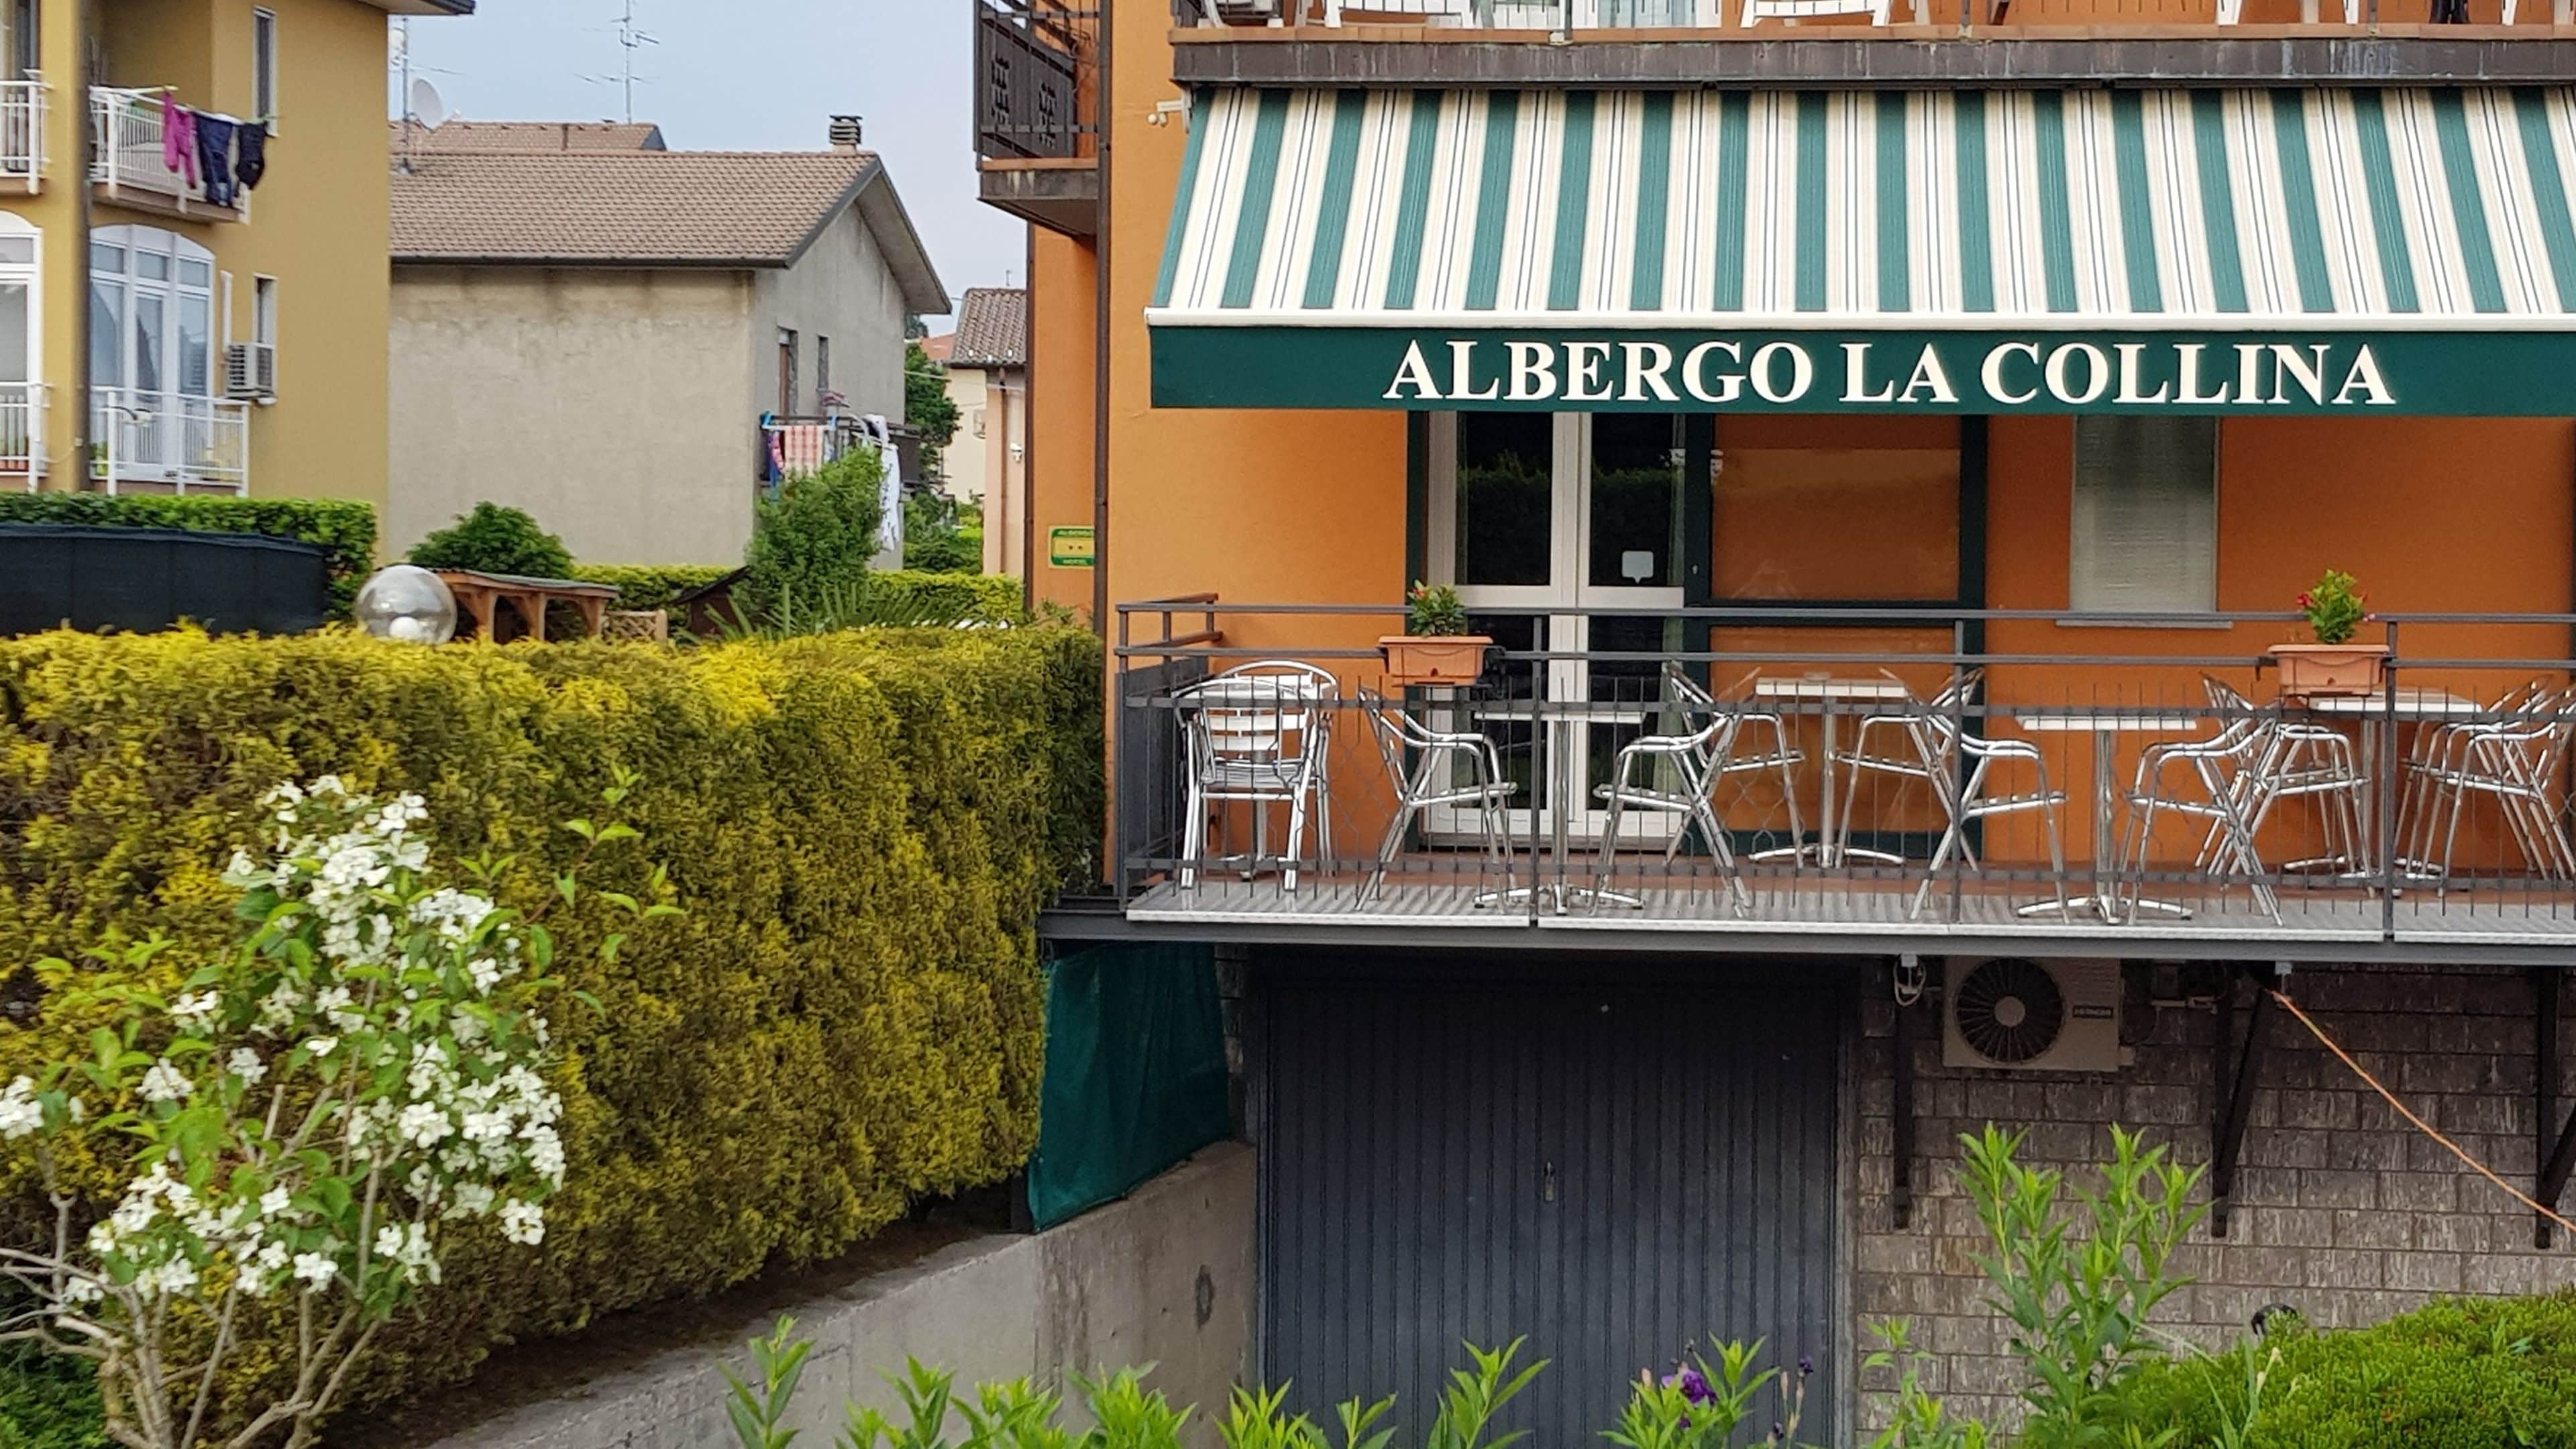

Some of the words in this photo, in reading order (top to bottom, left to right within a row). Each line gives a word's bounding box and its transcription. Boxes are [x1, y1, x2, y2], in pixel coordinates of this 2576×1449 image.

[1383, 339, 1813, 403] ALBERGO
[1839, 343, 1959, 402] LA
[1981, 342, 2396, 405] COLLINA
